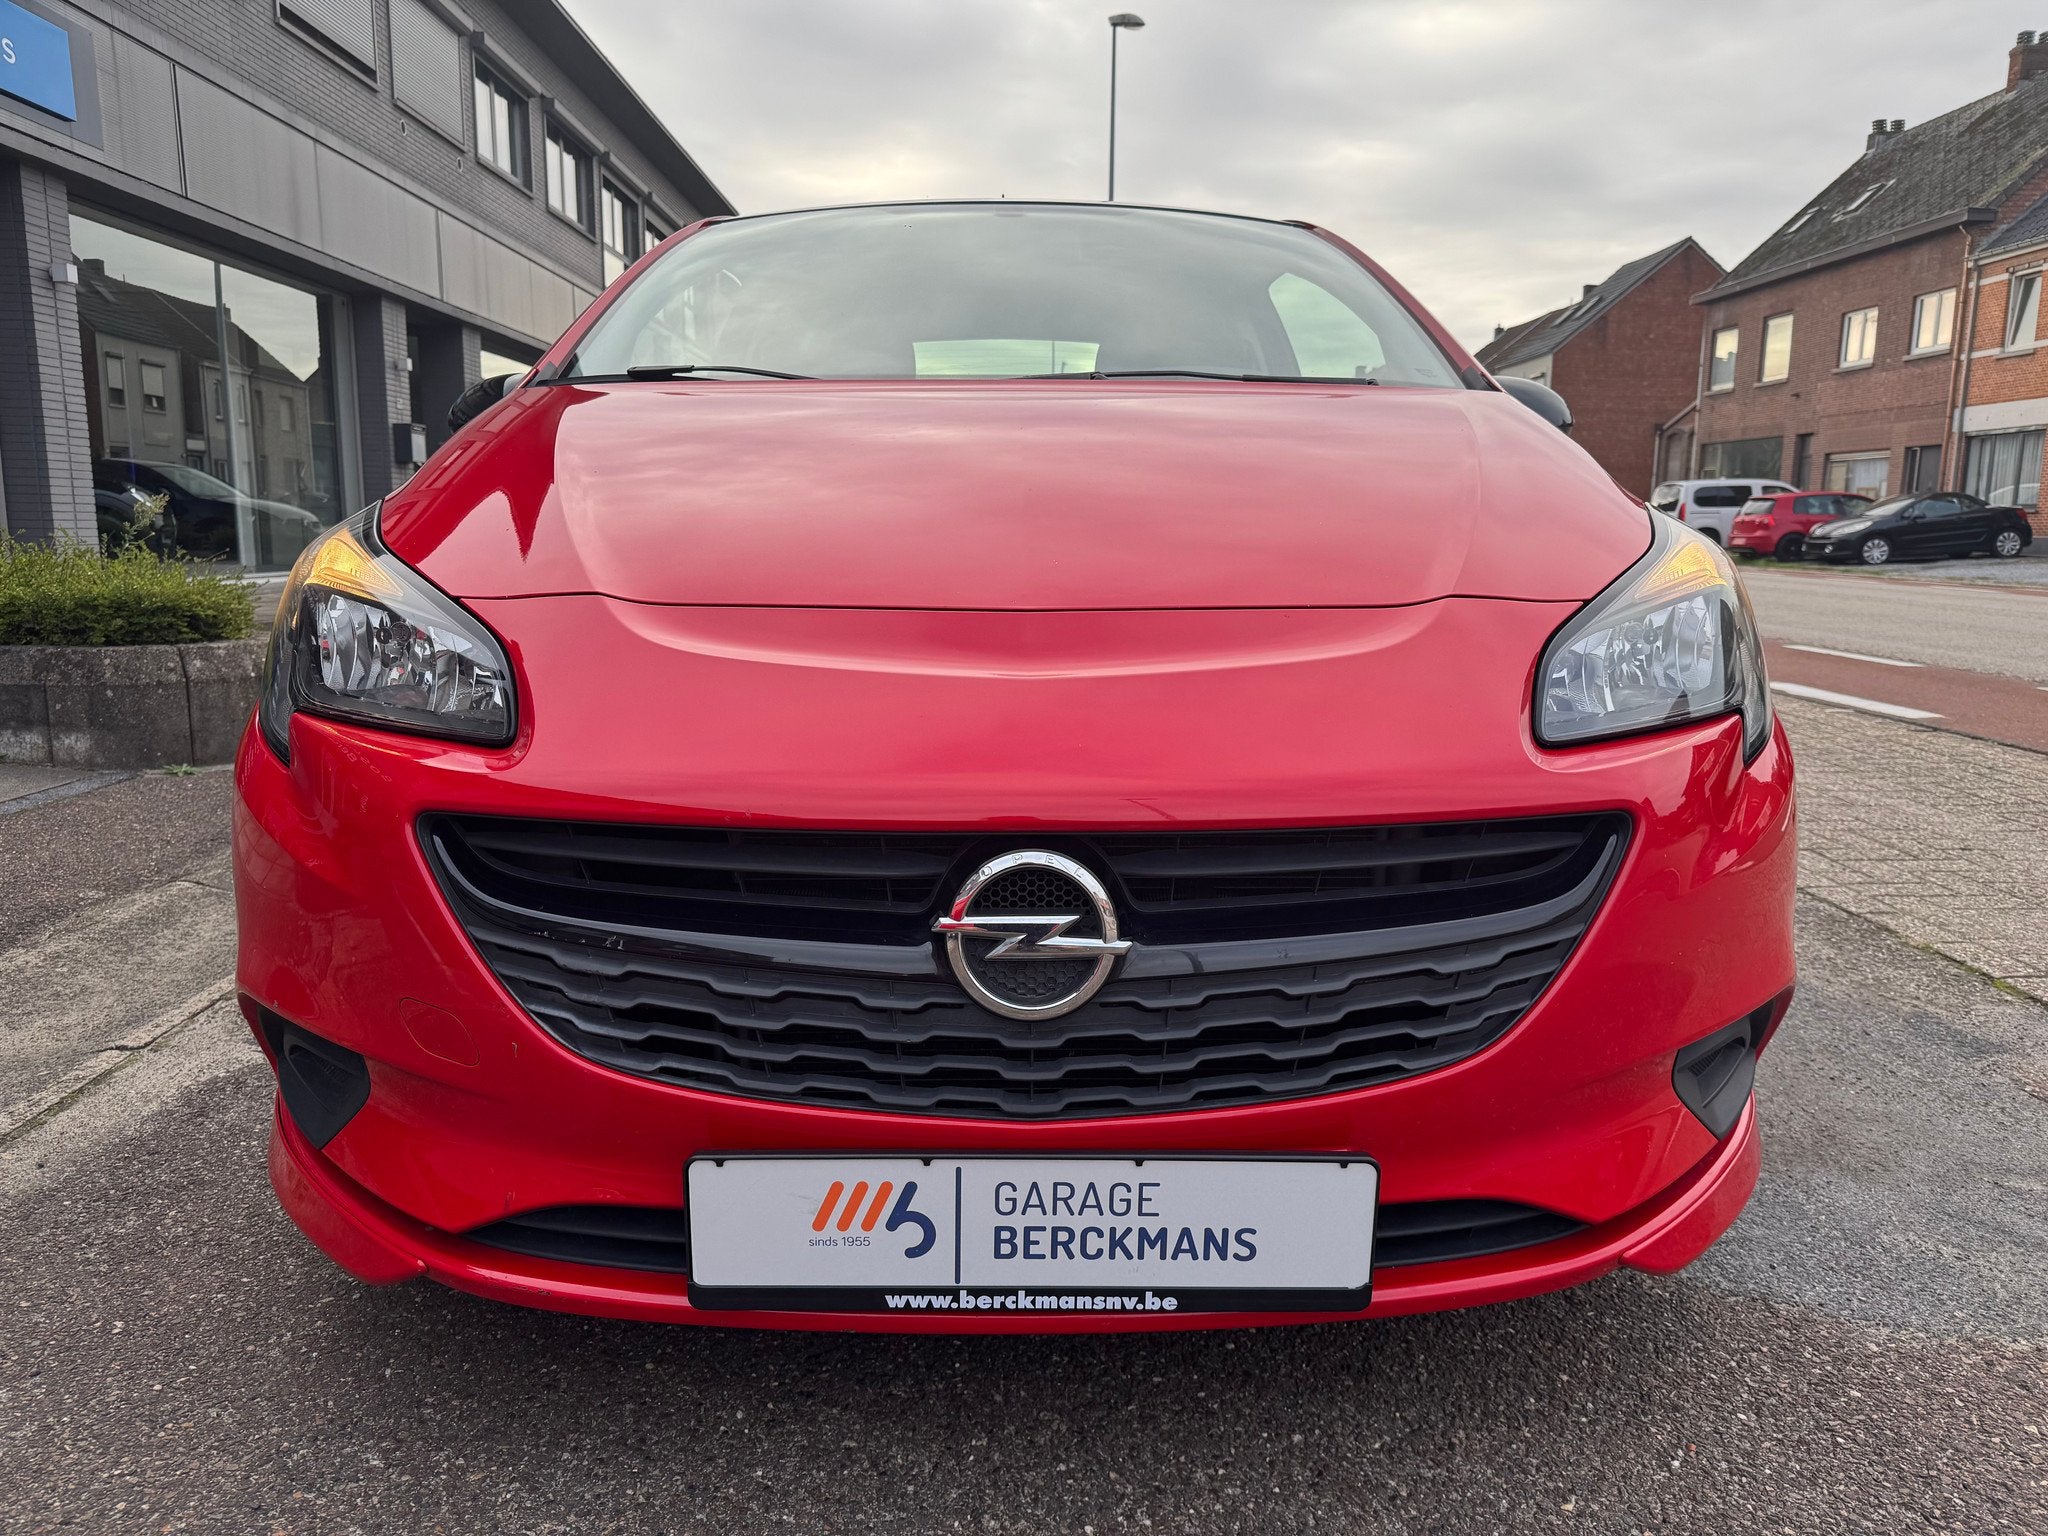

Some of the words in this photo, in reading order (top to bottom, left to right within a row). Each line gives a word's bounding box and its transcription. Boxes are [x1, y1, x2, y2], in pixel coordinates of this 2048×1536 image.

[979, 853, 1083, 878] OPEL
[994, 1181, 1161, 1217] GARAGE
[808, 1236, 838, 1247] sinds
[841, 1236, 871, 1247] 1955
[993, 1225, 1257, 1262] BERCKMANS
[885, 1290, 1178, 1310] www.berckmansnv.be
